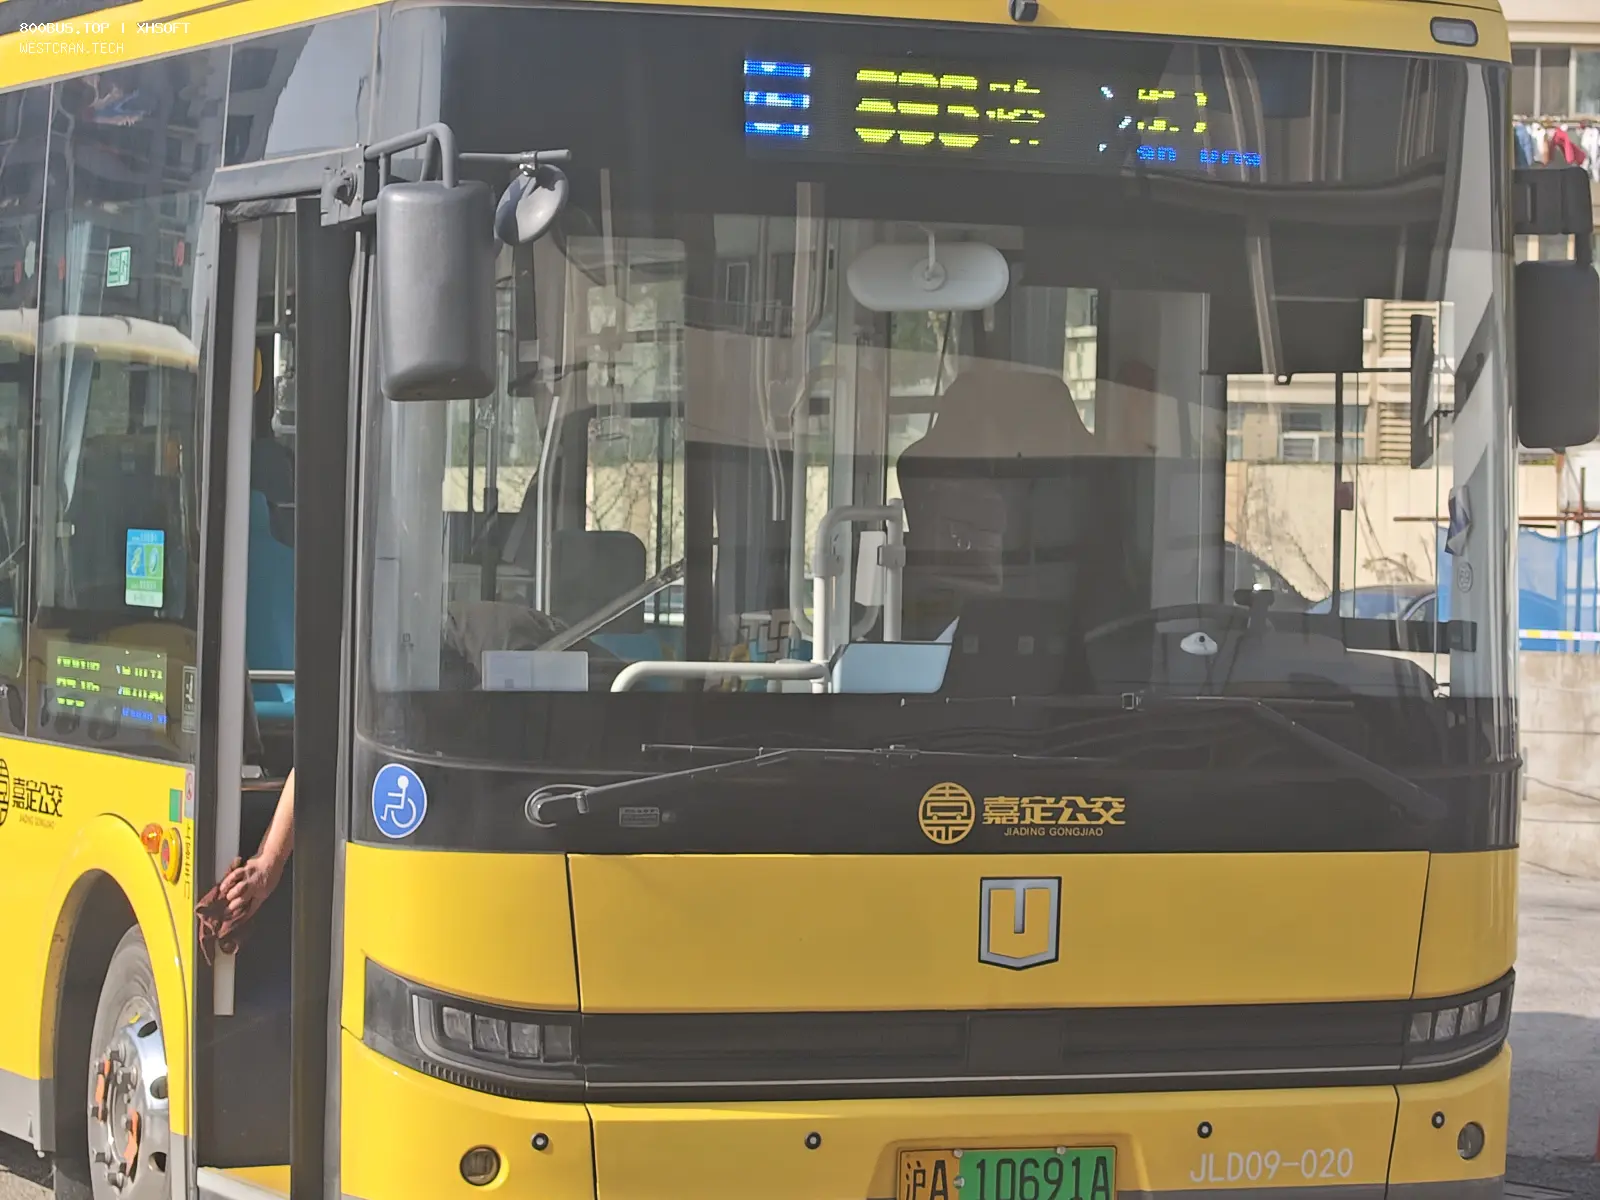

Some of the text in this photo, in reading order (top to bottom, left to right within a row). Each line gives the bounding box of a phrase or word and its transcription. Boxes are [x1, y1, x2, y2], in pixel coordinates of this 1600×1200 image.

[12, 777, 63, 817] 嘉定公交
[982, 795, 1126, 825] 嘉定公交
[1004, 826, 1104, 837] JIADING GONGJIAO
[975, 1156, 1111, 1200] 10691A
[1190, 1148, 1354, 1183] JLD09-020
